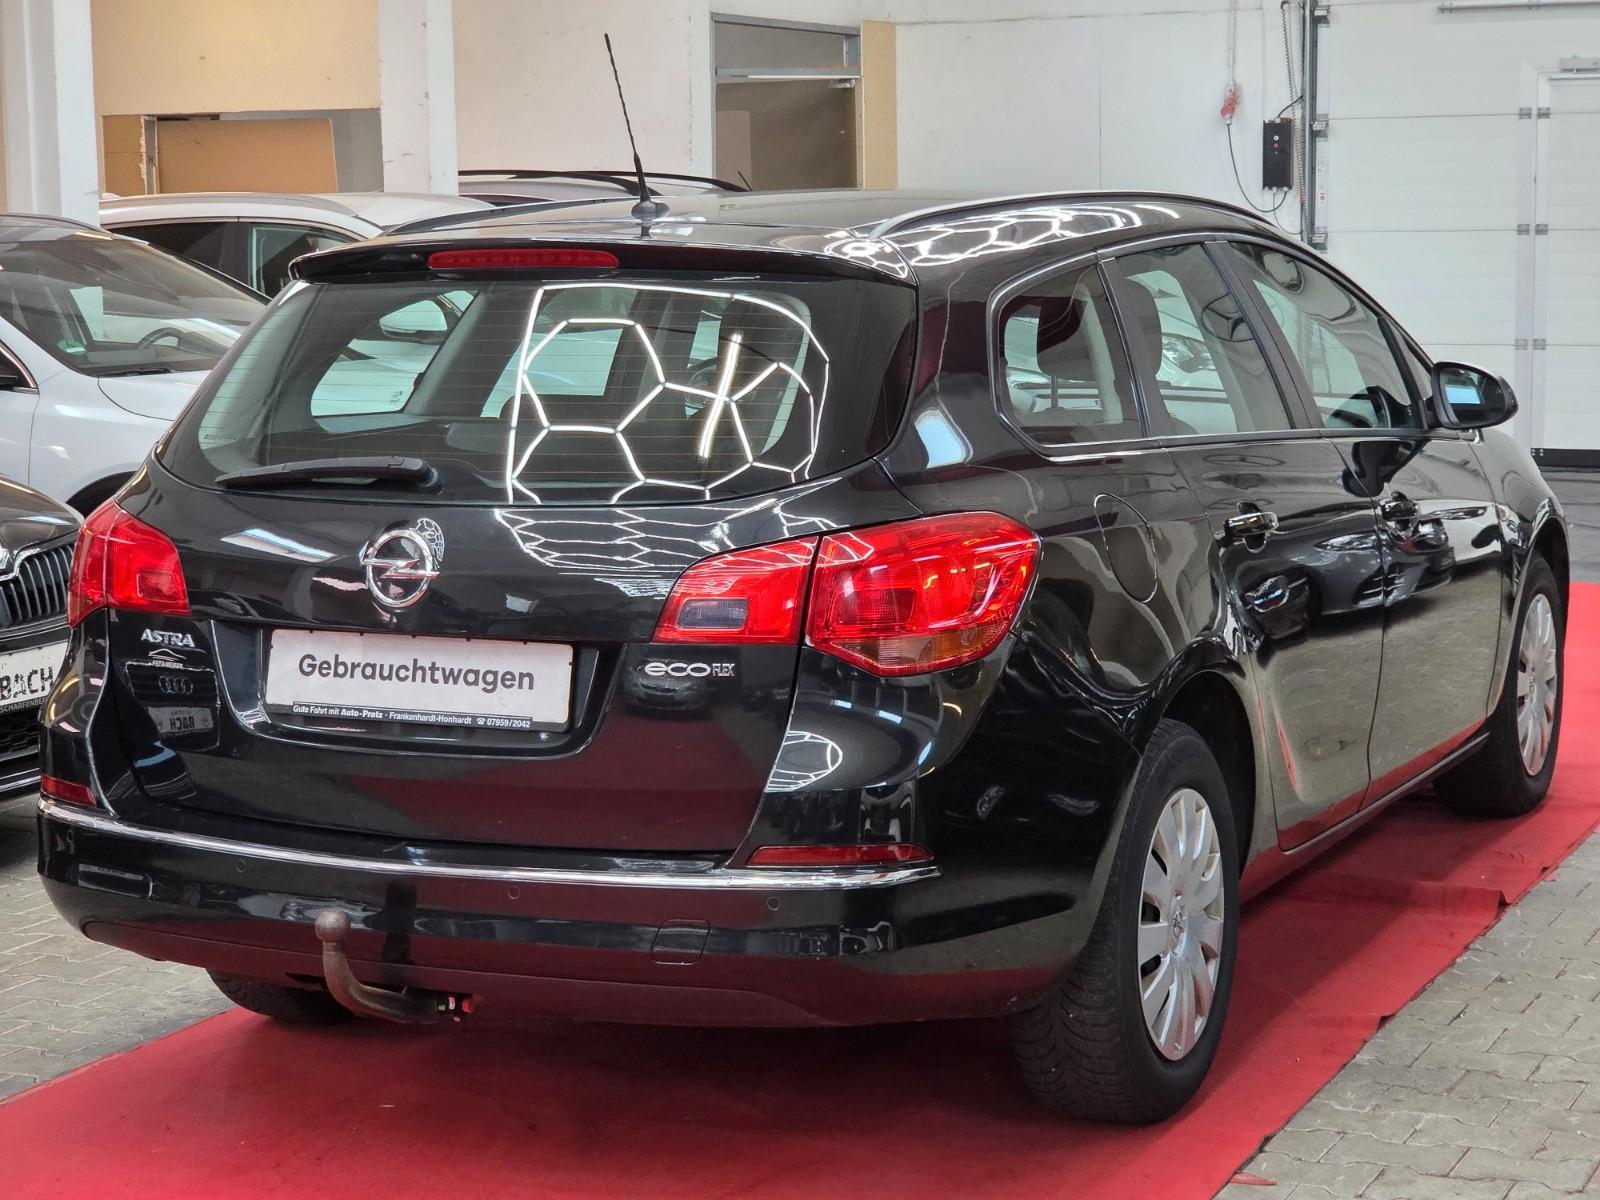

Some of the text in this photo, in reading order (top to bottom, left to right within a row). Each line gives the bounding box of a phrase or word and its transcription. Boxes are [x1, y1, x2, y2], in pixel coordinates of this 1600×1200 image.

[141, 629, 195, 648] ASTRA
[299, 653, 535, 694] Gebrauchtwagen
[293, 704, 309, 714] Gute
[310, 705, 328, 715] Fahrt
[328, 708, 340, 716] mit
[389, 711, 472, 725] Frankenhardt-Honhardt
[486, 717, 531, 728] 07959/2042
